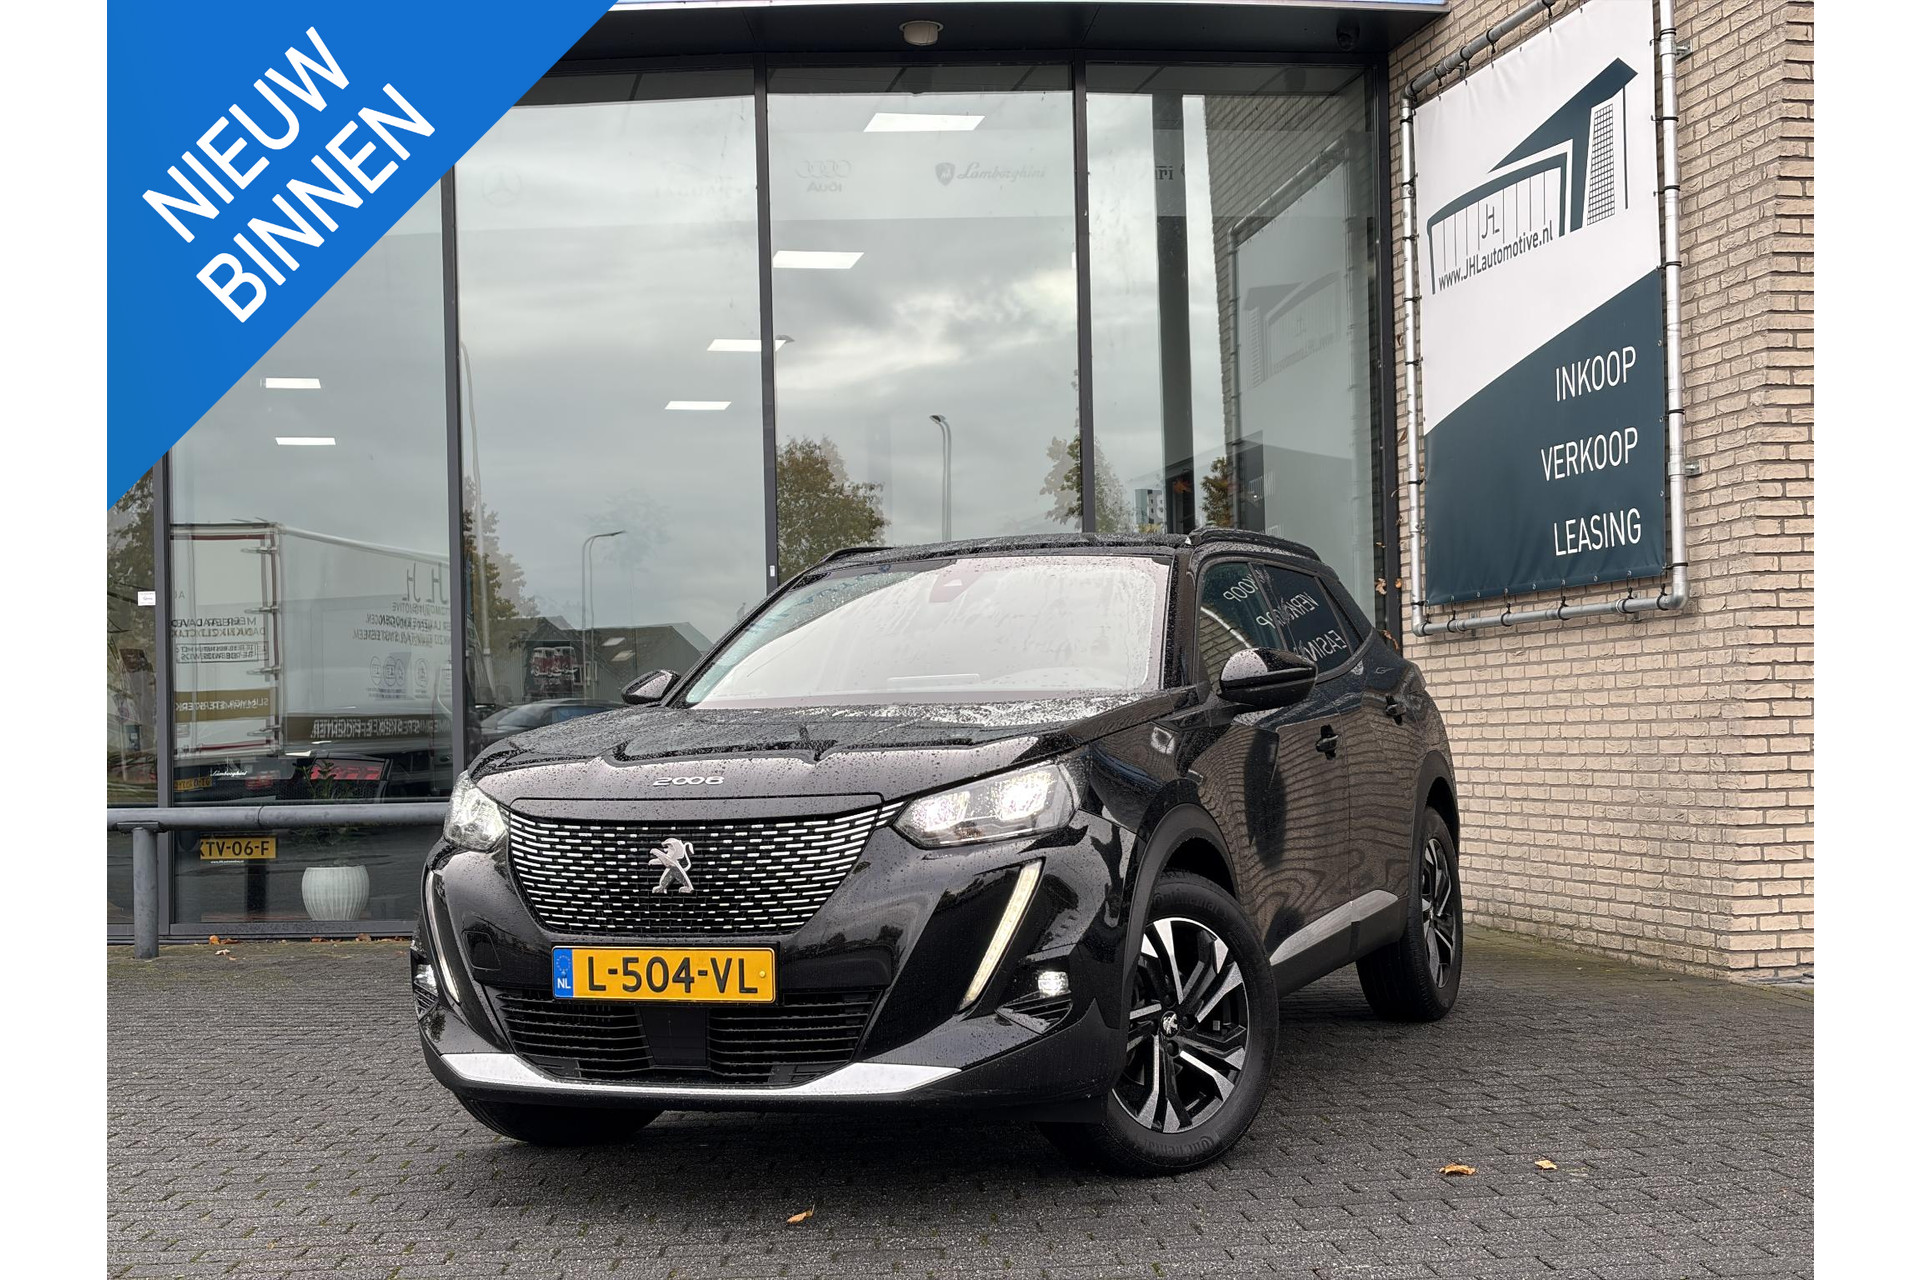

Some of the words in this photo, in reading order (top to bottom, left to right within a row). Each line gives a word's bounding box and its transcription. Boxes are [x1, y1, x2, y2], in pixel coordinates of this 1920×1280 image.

[957, 161, 1048, 183] Lamborghini
[1438, 220, 1553, 291] www.JHLautomotive.nl
[1555, 346, 1636, 402] INKOOP
[1541, 427, 1638, 481] VERKOOP
[1554, 508, 1643, 556] LEASING
[652, 776, 725, 787] 2008
[557, 977, 571, 989] NL
[587, 956, 758, 994] L-504-VL
